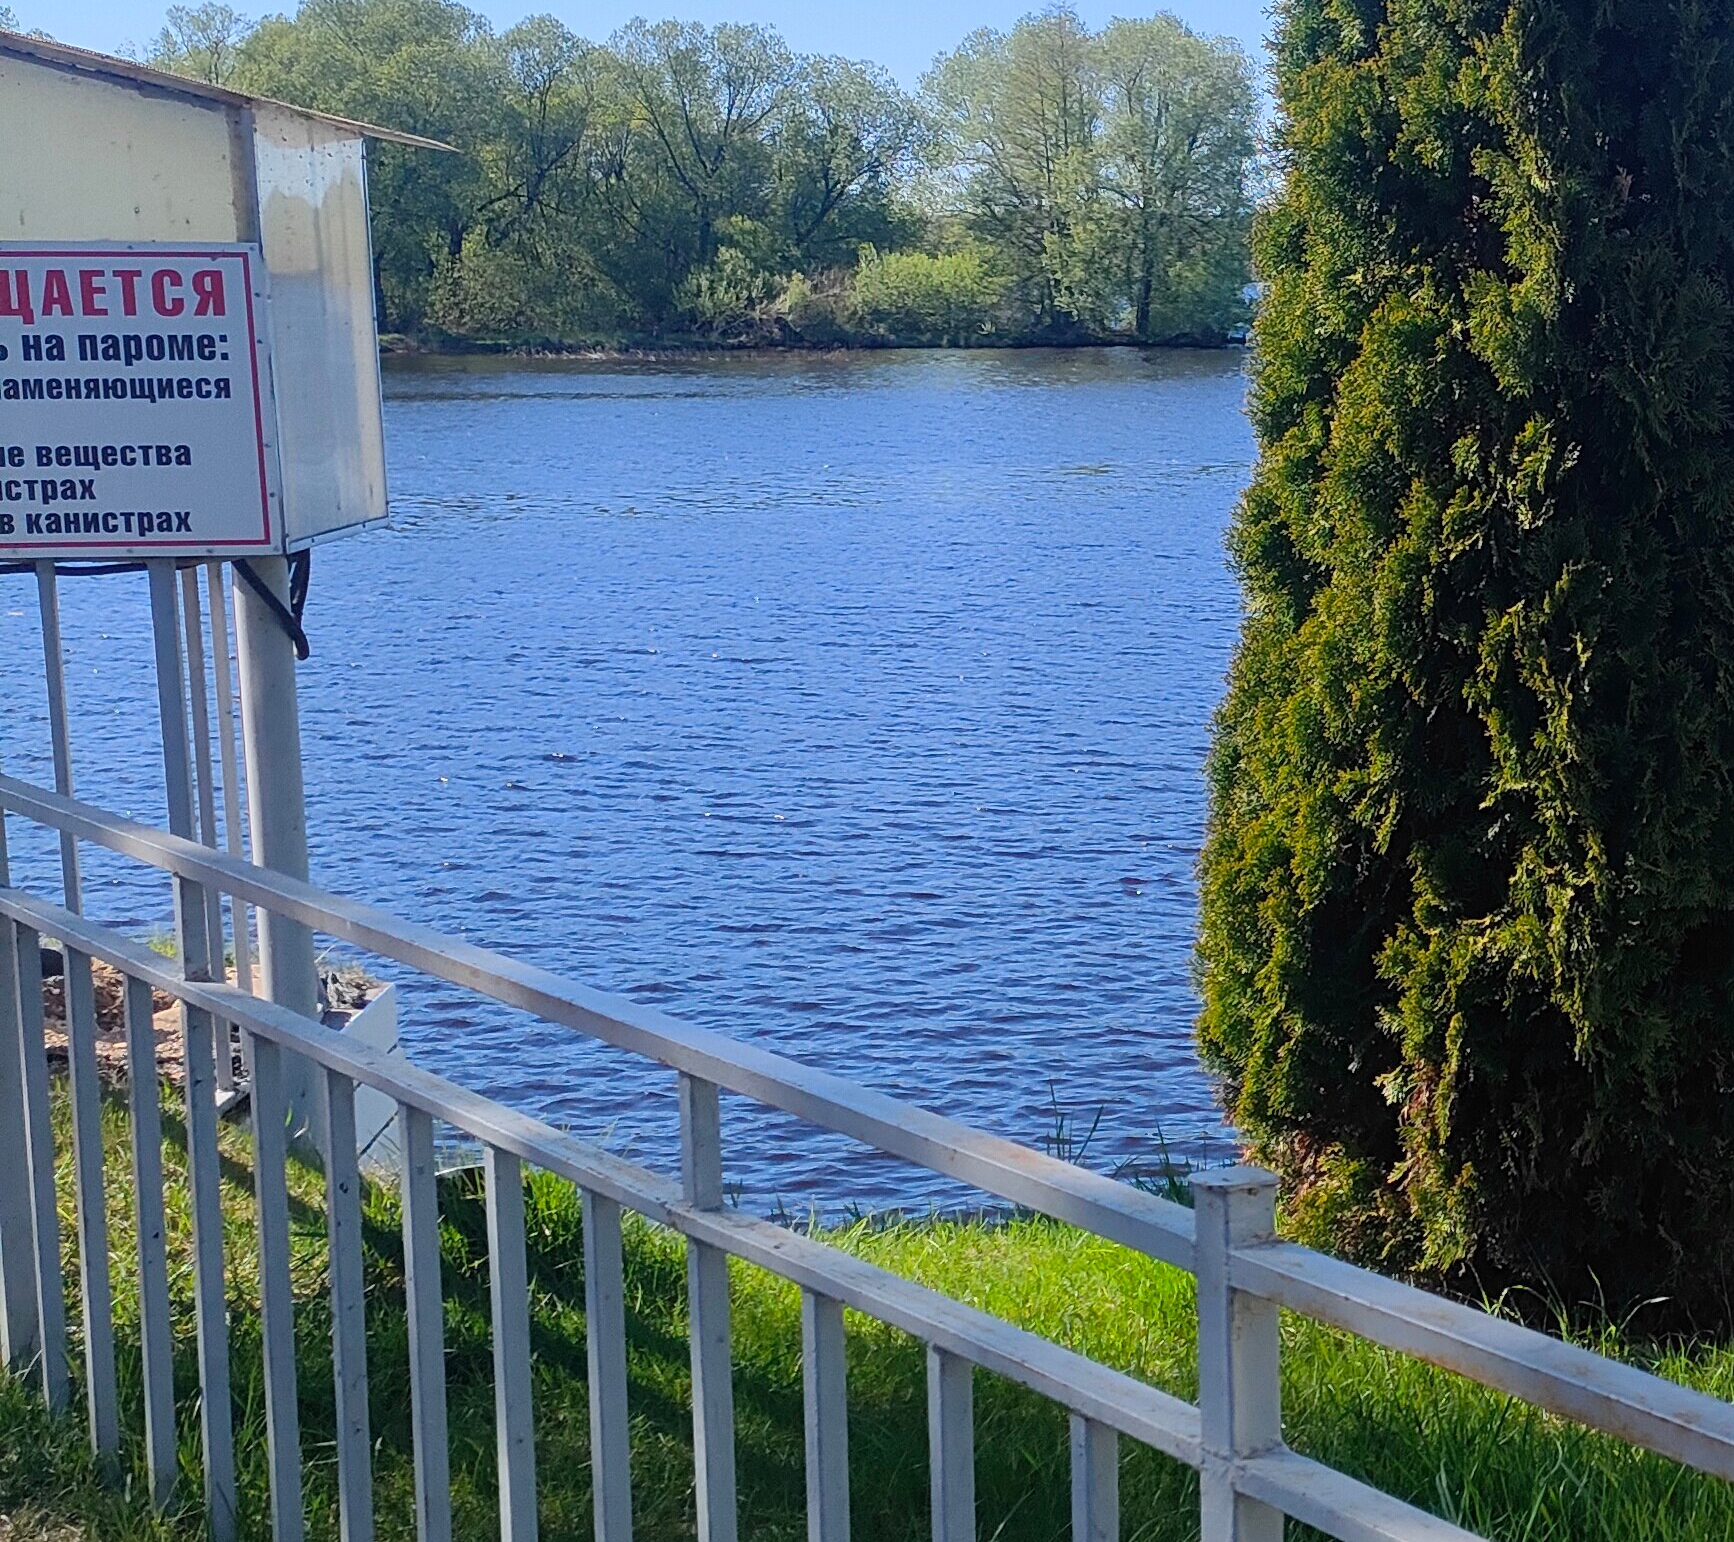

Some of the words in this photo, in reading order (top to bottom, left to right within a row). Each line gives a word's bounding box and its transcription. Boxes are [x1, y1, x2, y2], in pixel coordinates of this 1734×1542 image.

[0, 269, 226, 324] ЩАЕТСЯ
[21, 334, 65, 361] на
[78, 333, 229, 366] пароме:
[0, 378, 231, 403] аменяющиеся
[36, 444, 192, 470] вещества
[0, 479, 96, 504] страх
[26, 511, 192, 536] канистрах
